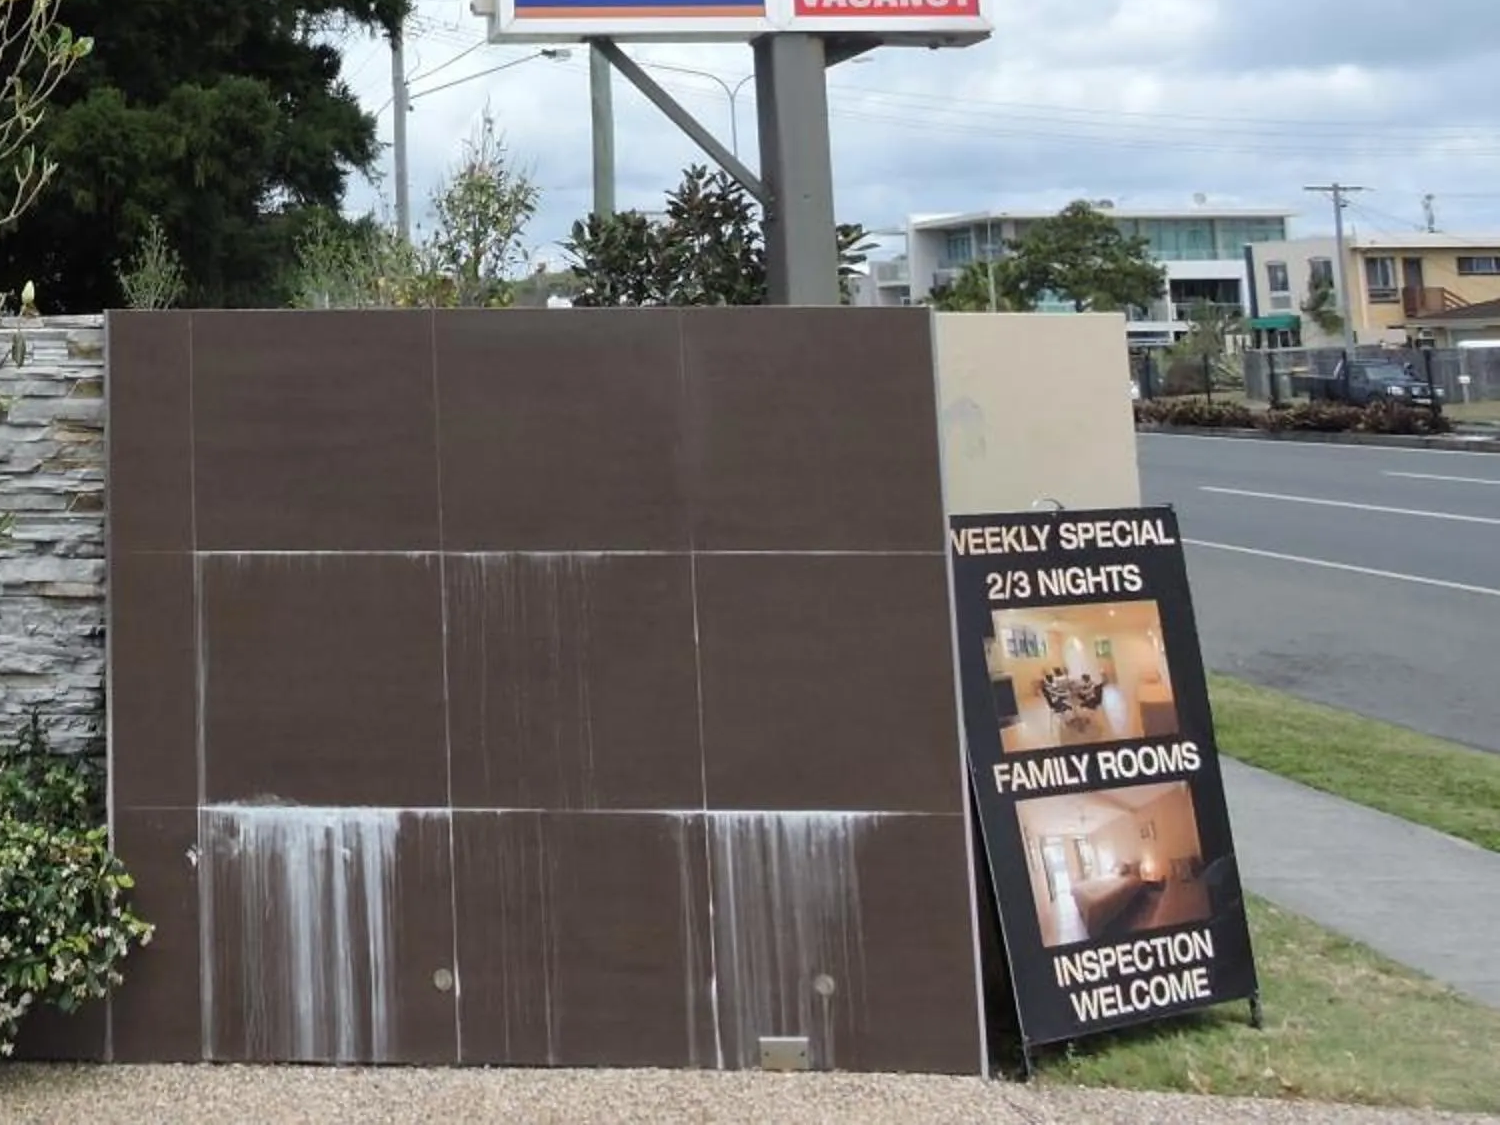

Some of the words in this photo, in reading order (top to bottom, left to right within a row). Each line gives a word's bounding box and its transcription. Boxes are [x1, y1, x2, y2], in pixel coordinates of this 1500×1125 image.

[1059, 518, 1175, 550] SPECIAL
[986, 571, 1031, 601] 2/3
[1037, 564, 1143, 596] NIGHTS
[993, 752, 1090, 794] FAMILY
[1096, 742, 1201, 781] ROOMS
[1053, 928, 1214, 987] INSPECTION
[1070, 966, 1212, 1023] WELCOME
